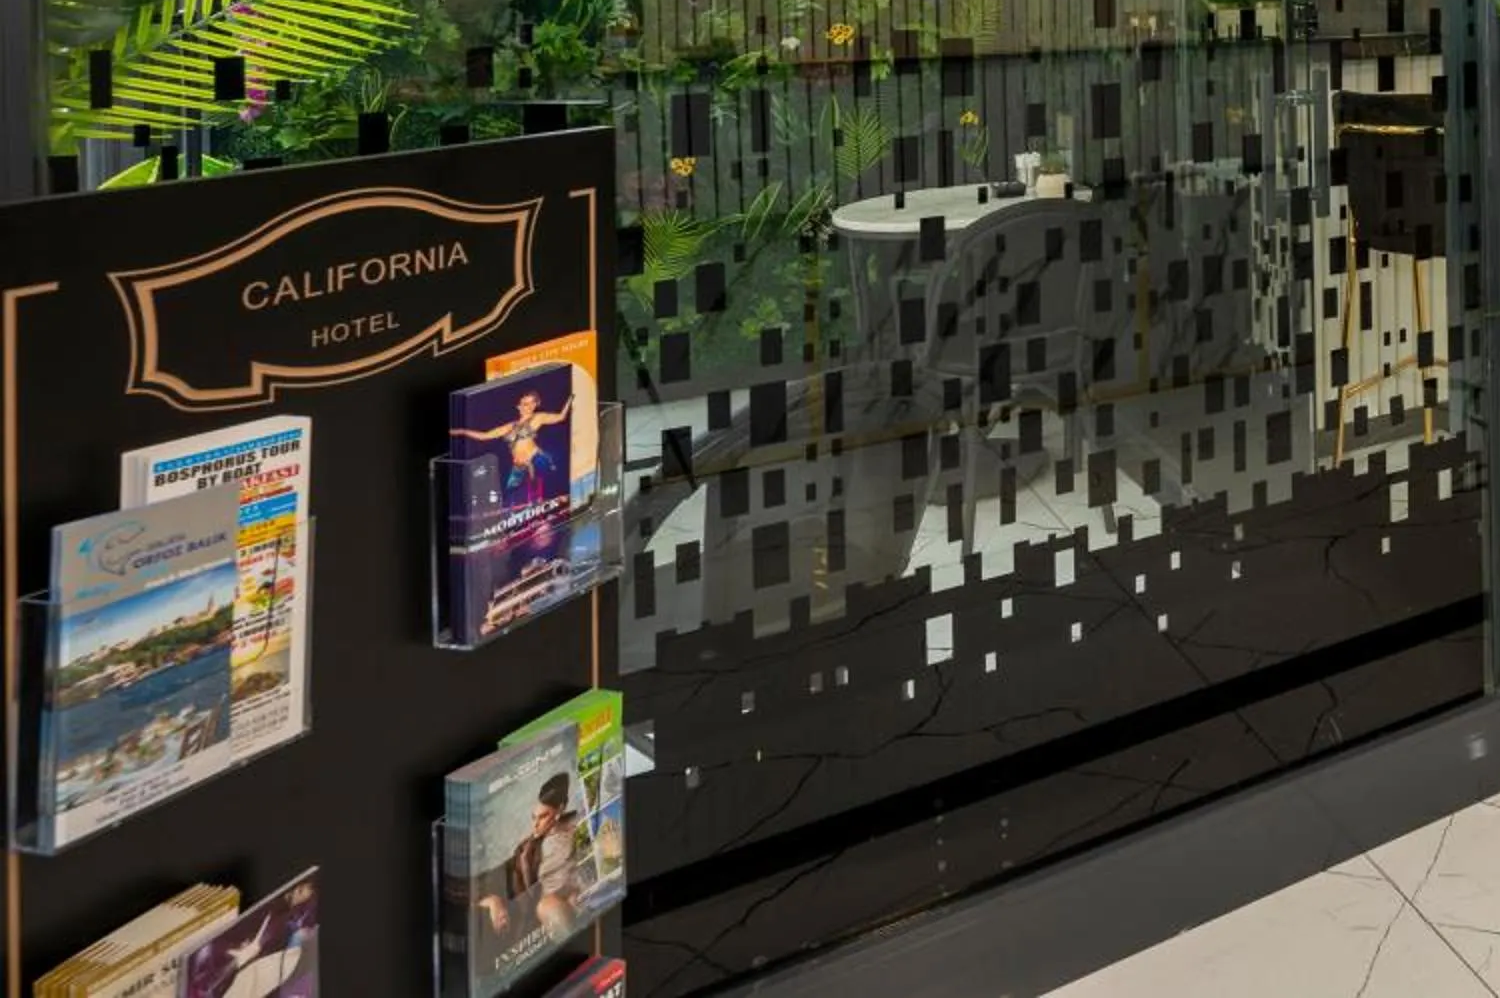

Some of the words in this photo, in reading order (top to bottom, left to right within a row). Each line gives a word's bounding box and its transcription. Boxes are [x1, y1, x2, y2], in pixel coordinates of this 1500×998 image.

[242, 240, 470, 311] CALIFORNIA
[311, 311, 401, 348] HOTEL
[262, 439, 301, 459] TOUR
[197, 476, 218, 490] BY
